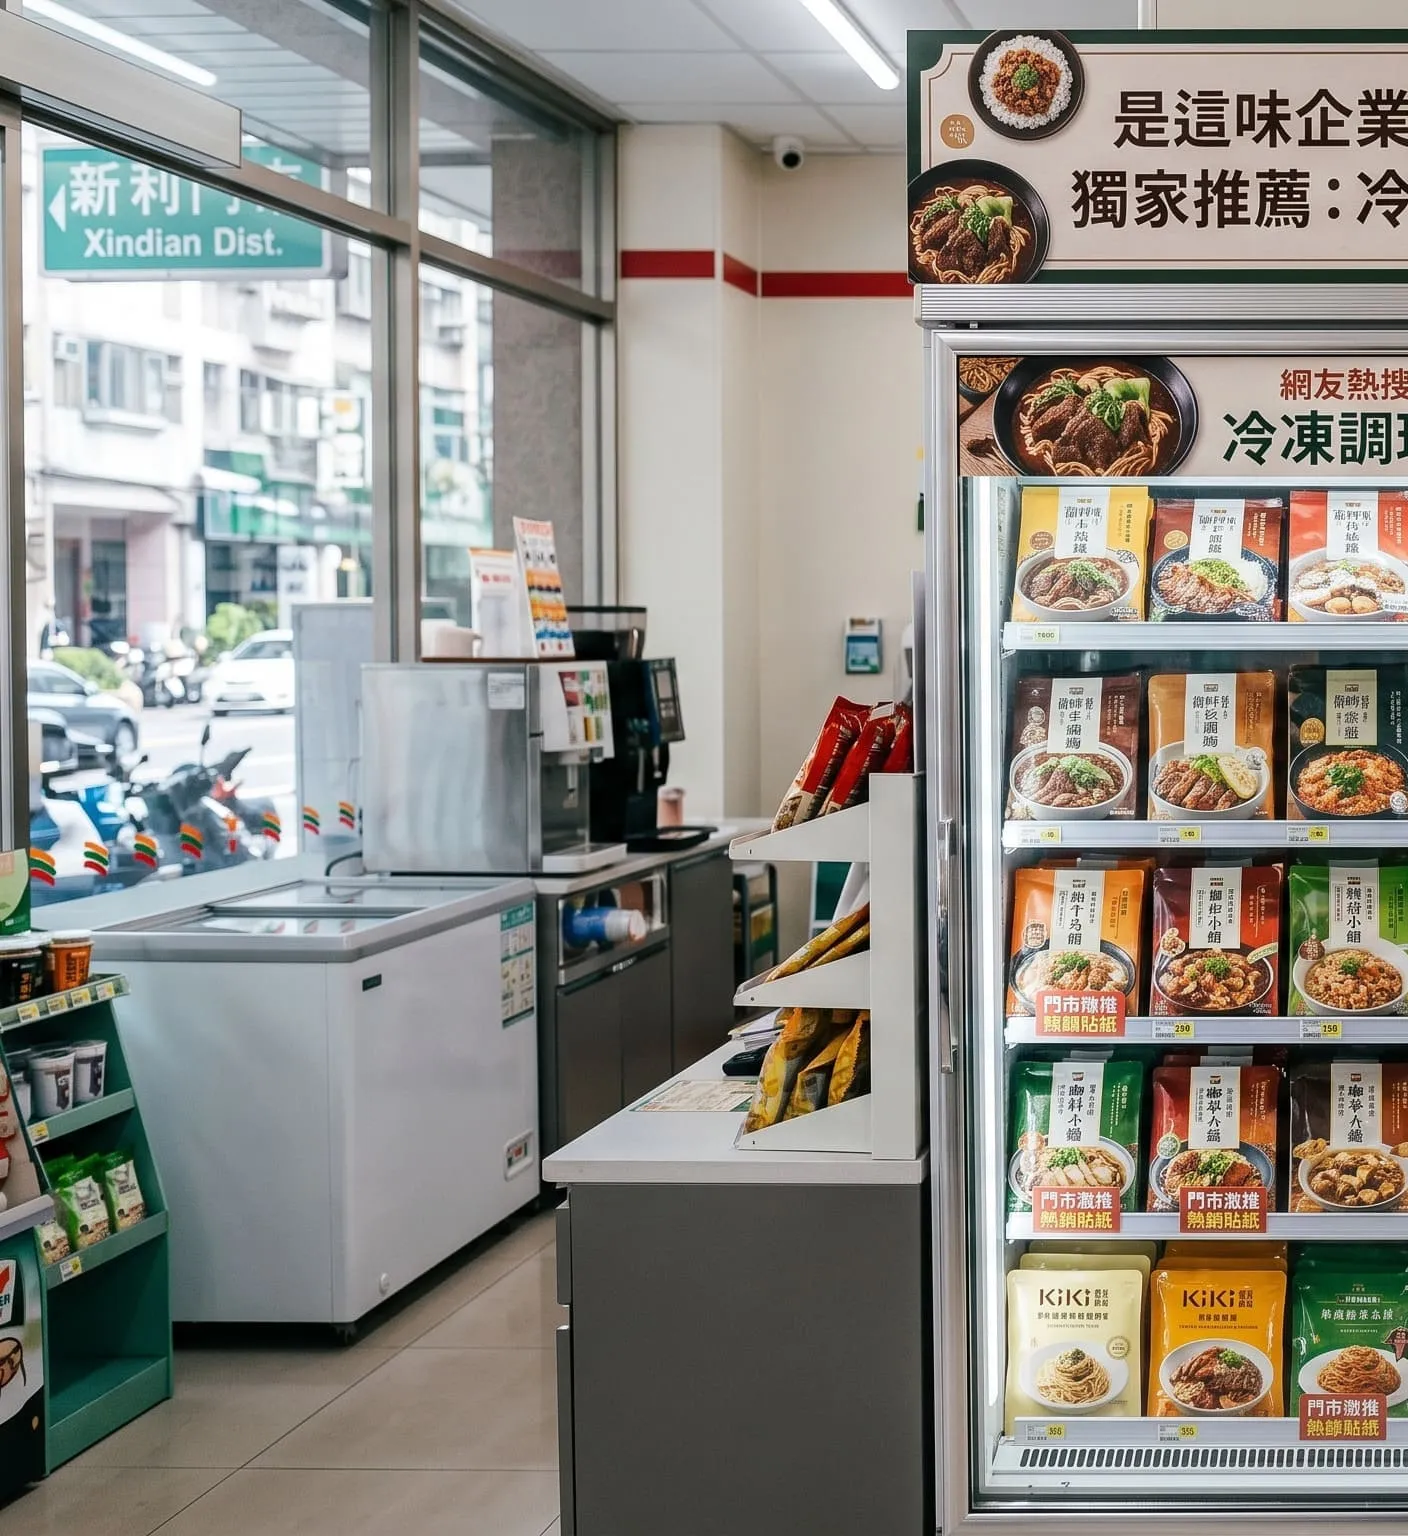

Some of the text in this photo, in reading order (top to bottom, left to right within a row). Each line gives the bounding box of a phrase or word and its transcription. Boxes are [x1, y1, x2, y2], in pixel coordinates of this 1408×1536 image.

[83, 226, 284, 258] Xindian Dist.
[1039, 1287, 1091, 1307] KiKi
[1182, 1288, 1235, 1308] KiKi
